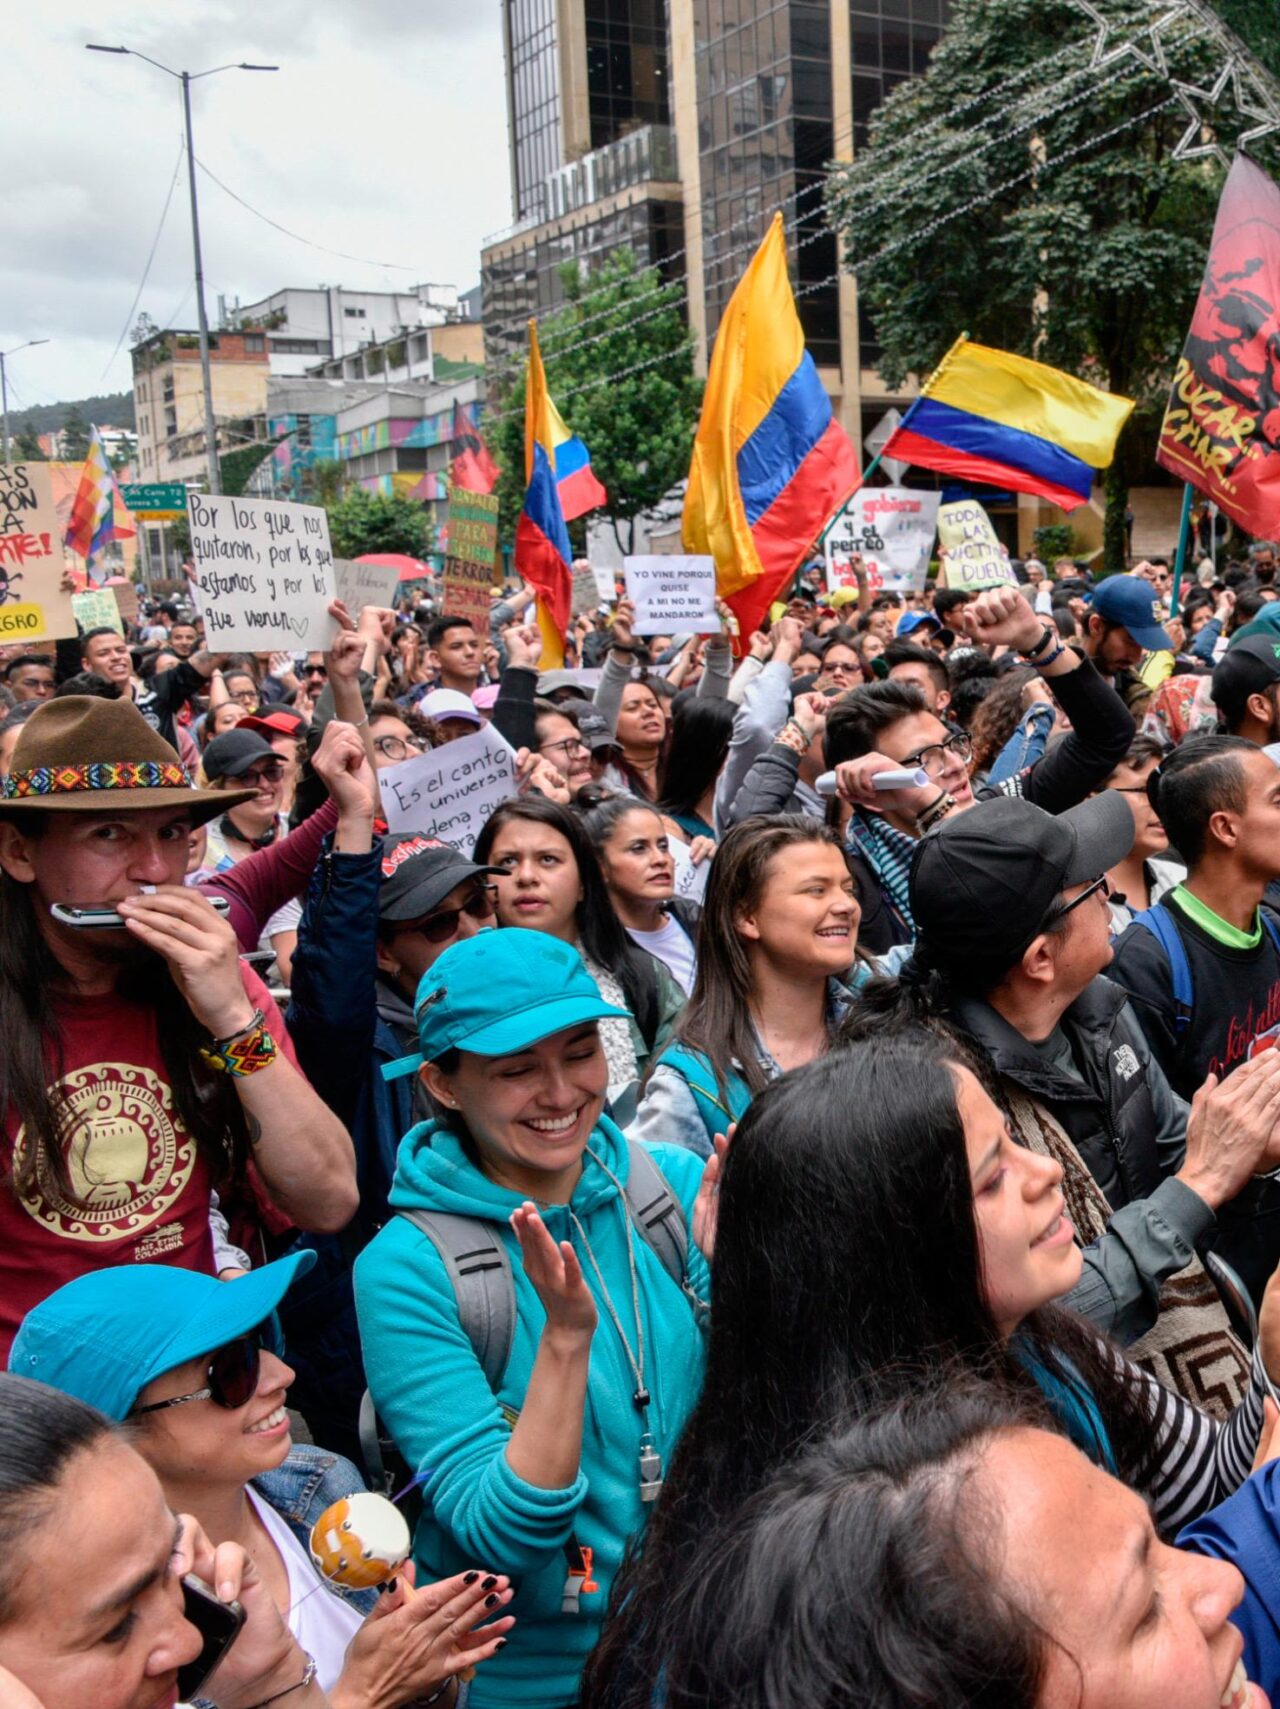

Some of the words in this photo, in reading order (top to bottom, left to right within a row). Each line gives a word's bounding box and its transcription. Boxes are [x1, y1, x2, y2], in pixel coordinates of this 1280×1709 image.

[189, 494, 219, 528] Por
[231, 501, 257, 530] los
[264, 511, 294, 540] que
[303, 515, 323, 539] nos
[269, 545, 291, 568] por
[297, 538, 312, 566] los
[315, 548, 332, 572] que
[446, 556, 493, 581] TERROR
[200, 571, 257, 599] estamos
[267, 579, 276, 601] y
[284, 578, 302, 595] por
[313, 574, 327, 595] los
[660, 584, 689, 592] QUISE
[205, 607, 236, 632] que
[649, 611, 704, 619] MANDARON
[427, 769, 443, 793] el
[451, 746, 507, 782] canto
[429, 755, 516, 810] universal
